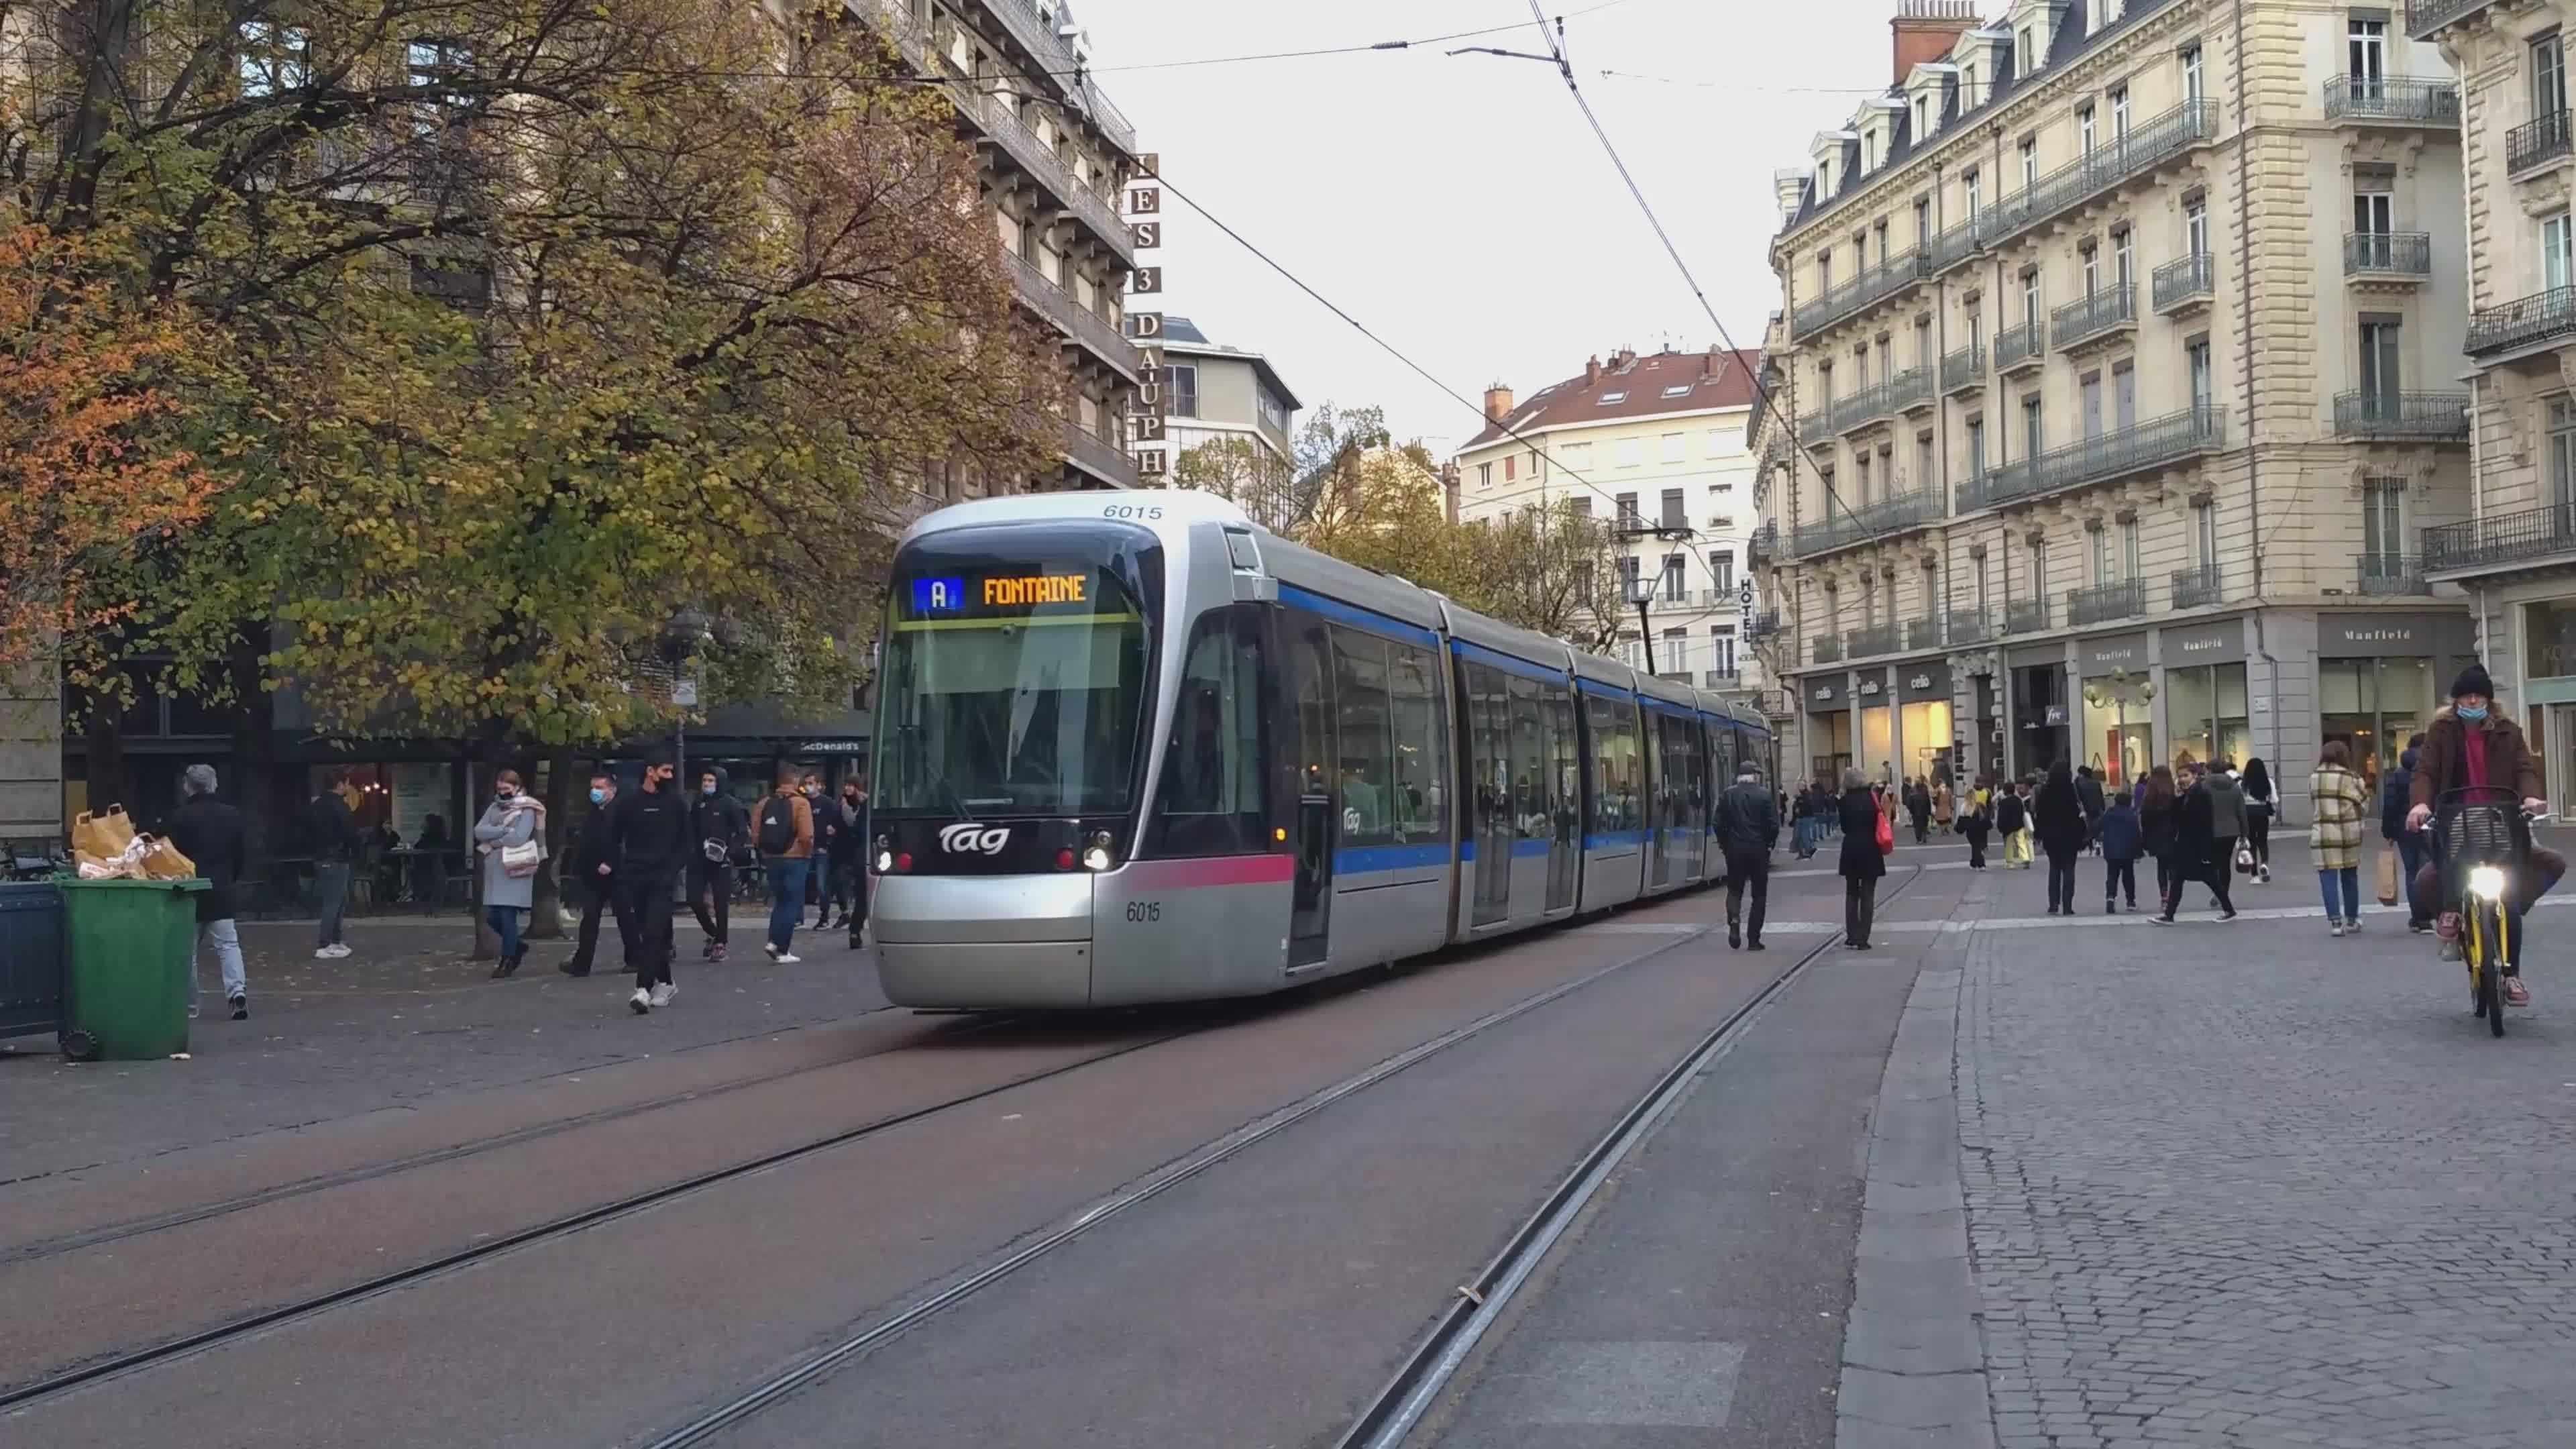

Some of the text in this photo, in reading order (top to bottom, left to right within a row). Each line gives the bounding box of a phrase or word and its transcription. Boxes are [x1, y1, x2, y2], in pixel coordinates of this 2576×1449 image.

[1135, 155, 1163, 489] LES 3 DAUPH
[1104, 505, 1163, 520] 6015
[931, 575, 1086, 608] A FONTAINE
[1740, 579, 1752, 643] HOTEL
[2345, 629, 2410, 640] Manfield
[1127, 901, 1160, 922] 6015
